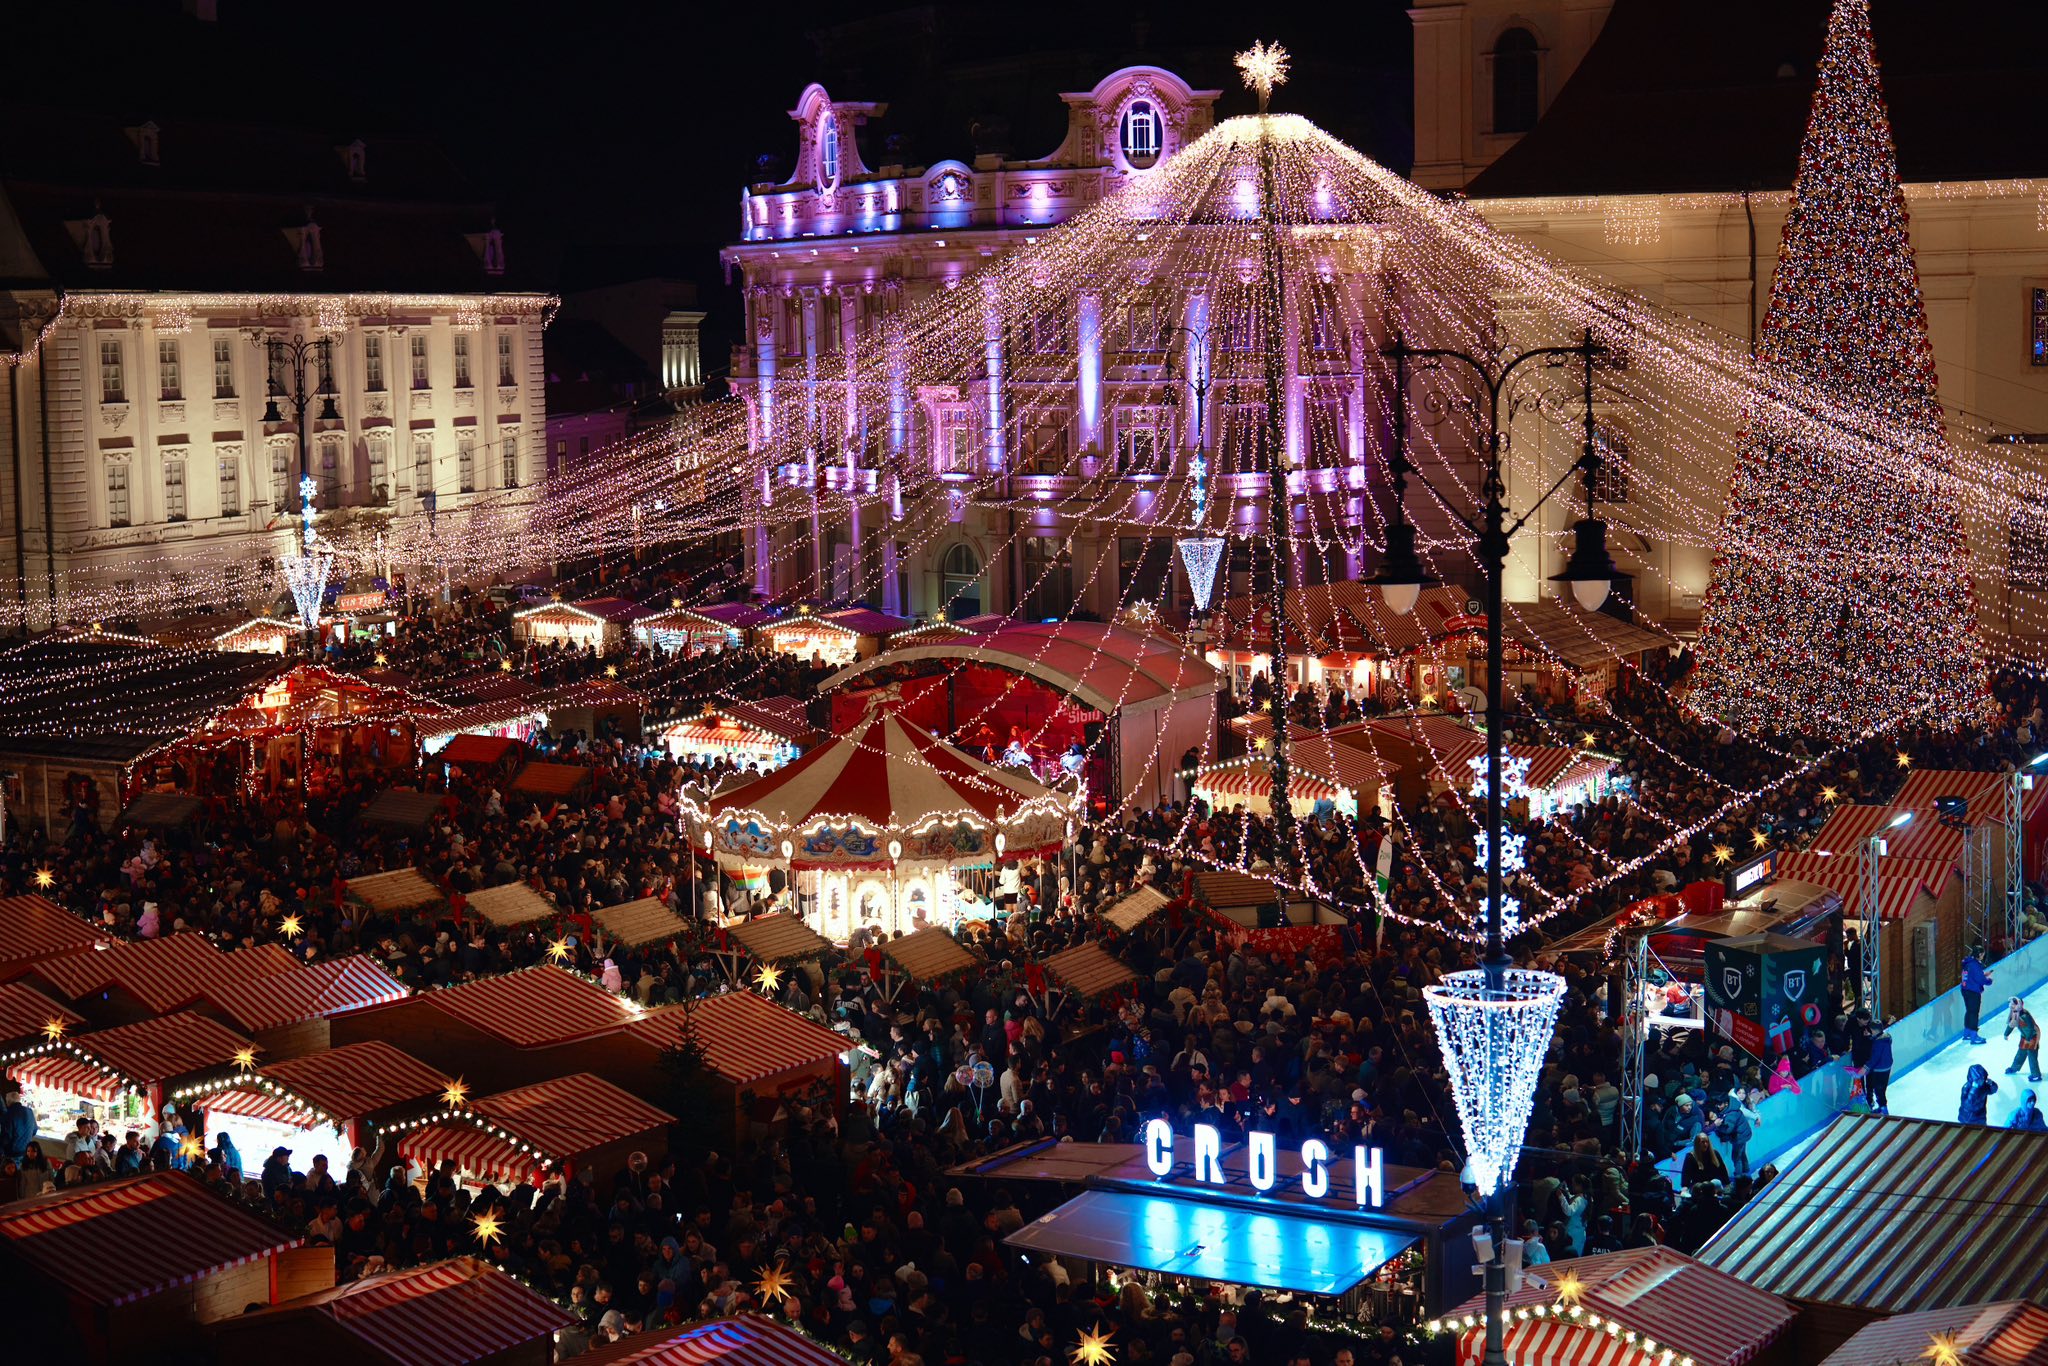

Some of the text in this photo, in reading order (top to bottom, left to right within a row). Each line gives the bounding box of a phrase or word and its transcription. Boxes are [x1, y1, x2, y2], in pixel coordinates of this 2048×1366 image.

[1726, 974, 1739, 987] BT
[1788, 976, 1801, 989] BT
[1146, 1117, 1384, 1208] CRUSH
